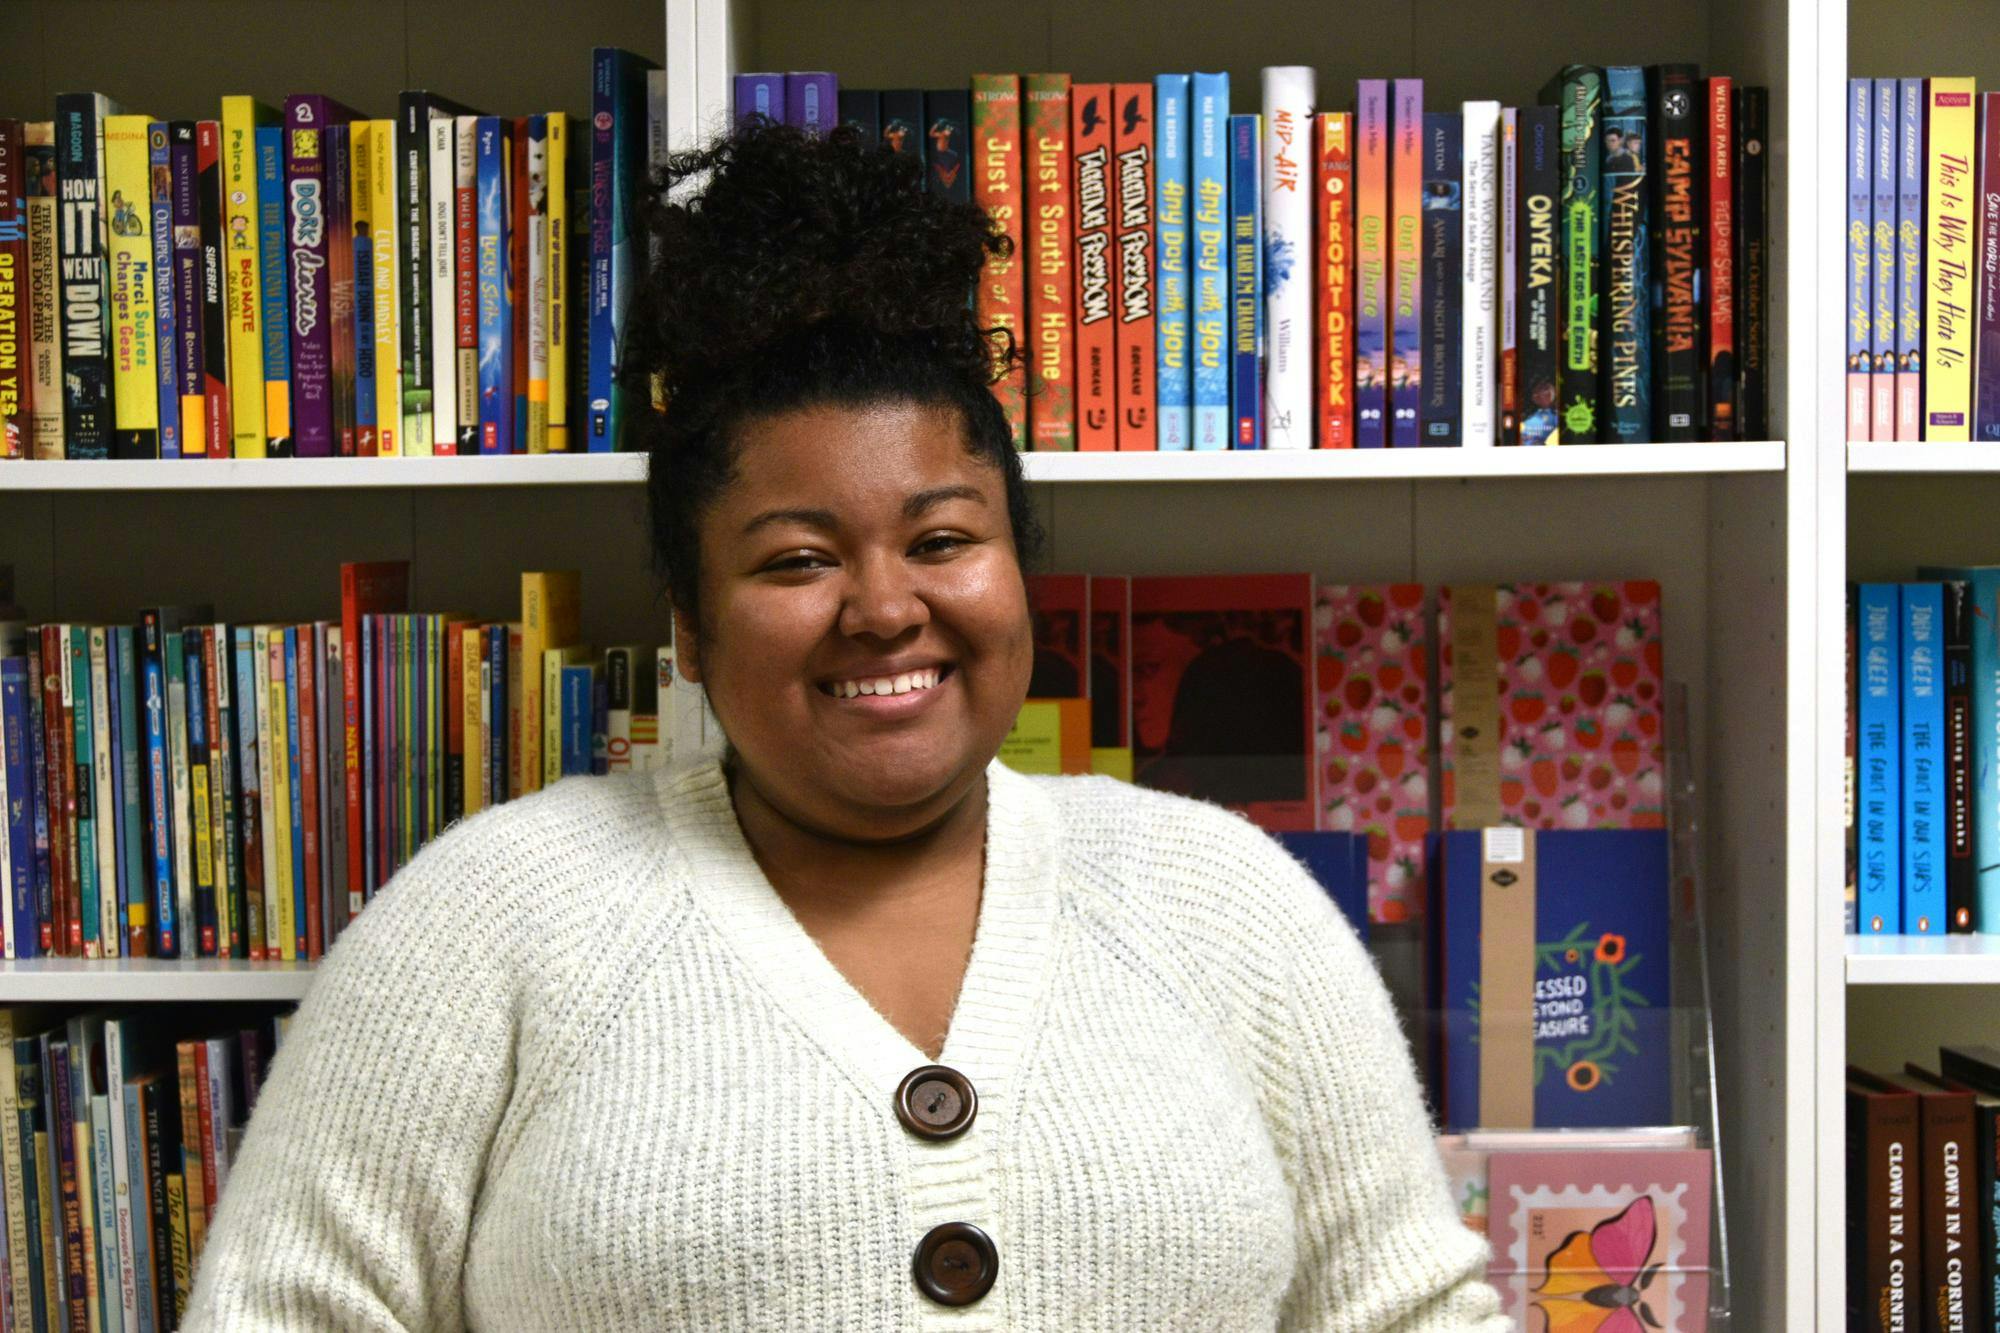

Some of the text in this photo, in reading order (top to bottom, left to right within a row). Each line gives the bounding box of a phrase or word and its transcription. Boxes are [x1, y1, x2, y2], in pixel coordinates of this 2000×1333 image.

[70, 112, 82, 162] MAGOON
[106, 131, 146, 141] MEDINA
[1322, 161, 1350, 171] YANG
[1435, 127, 1445, 171] ALSTON
[1664, 138, 1691, 222] CAMP
[1715, 85, 1726, 178] WENDY PARRIS
[43, 231, 52, 291] SECRET
[294, 182, 321, 245] DORK
[987, 138, 1012, 304] Just of
[1039, 138, 1066, 380] Just South of Home
[1078, 146, 1110, 325] TAGGING FREEDOM
[1118, 145, 1152, 324] TAGGING FREEDOM
[1159, 179, 1185, 272] Any Day
[1197, 178, 1222, 272] Any Day
[1466, 160, 1477, 282] The Secret of Safe Passage
[1480, 133, 1494, 312] TAKING WONDERLAND
[1527, 195, 1553, 288] ONYEKA
[1611, 177, 1645, 333] WHISPERING
[1713, 200, 1732, 323] FIELD OF SCREAMS
[1932, 153, 1969, 368] This Is Why They Hate Us
[1986, 193, 2000, 272] SAVE WORLD
[31, 205, 44, 342] SILVER DOLPHIN
[62, 179, 101, 356] HOW IT WENT DOWN
[113, 251, 134, 372] Changes Gears
[133, 262, 148, 304] Merci
[155, 209, 171, 319] OLYMPIC DREAMS
[183, 258, 197, 369] MYSTERY ROMAN
[205, 246, 218, 303] SUPERFAN
[242, 291, 254, 332] NATE
[376, 229, 392, 344] LILA AND HADLEY
[462, 192, 472, 342] WHEN YOU REACH ME
[1236, 215, 1255, 354] THE HARLEM CHARADE
[1327, 200, 1345, 406] FRONT DESK
[1362, 214, 1382, 318] Out There
[1398, 214, 1418, 318] Out There
[1665, 227, 1693, 352] SYLVANIA
[1748, 241, 1760, 369] The October Society
[0, 253, 18, 416] OPERATION YES
[358, 290, 373, 378] DUNN HERO
[1278, 318, 1291, 373] Williams
[1432, 300, 1445, 407] NIGHT BROTHERS
[1474, 326, 1483, 406] MARTIN BAYNTON
[1613, 340, 1639, 408] PINES
[1867, 605, 1888, 696] JOHN GREEN
[1910, 604, 1933, 697] JOHN GREEN
[75, 699, 86, 731] DIVE
[346, 727, 359, 769] NATE
[467, 694, 479, 727] LIGHT
[1867, 722, 1886, 892] THE IN OUR STARS
[1912, 722, 1932, 893] THE IN OUR STARS
[1954, 707, 1965, 846] looking for alaska
[1534, 976, 1587, 998] ESSED
[5, 1097, 20, 1158] SILENT
[148, 1109, 163, 1215] THE STRANGER
[205, 1134, 214, 1186] PATERSON
[98, 1128, 113, 1228] LOSING UNCLE TIM
[13, 1211, 27, 1268] SILENT
[119, 1208, 134, 1310] Donovan's Big Day
[169, 1186, 185, 1280] The Little
[1888, 1142, 1905, 1333] CLOWN IN A CORNFI
[1943, 1141, 1964, 1333] CLOWN IN A CORNFI
[15, 1278, 30, 1329] DREAM
[138, 1279, 148, 1320] Homes
